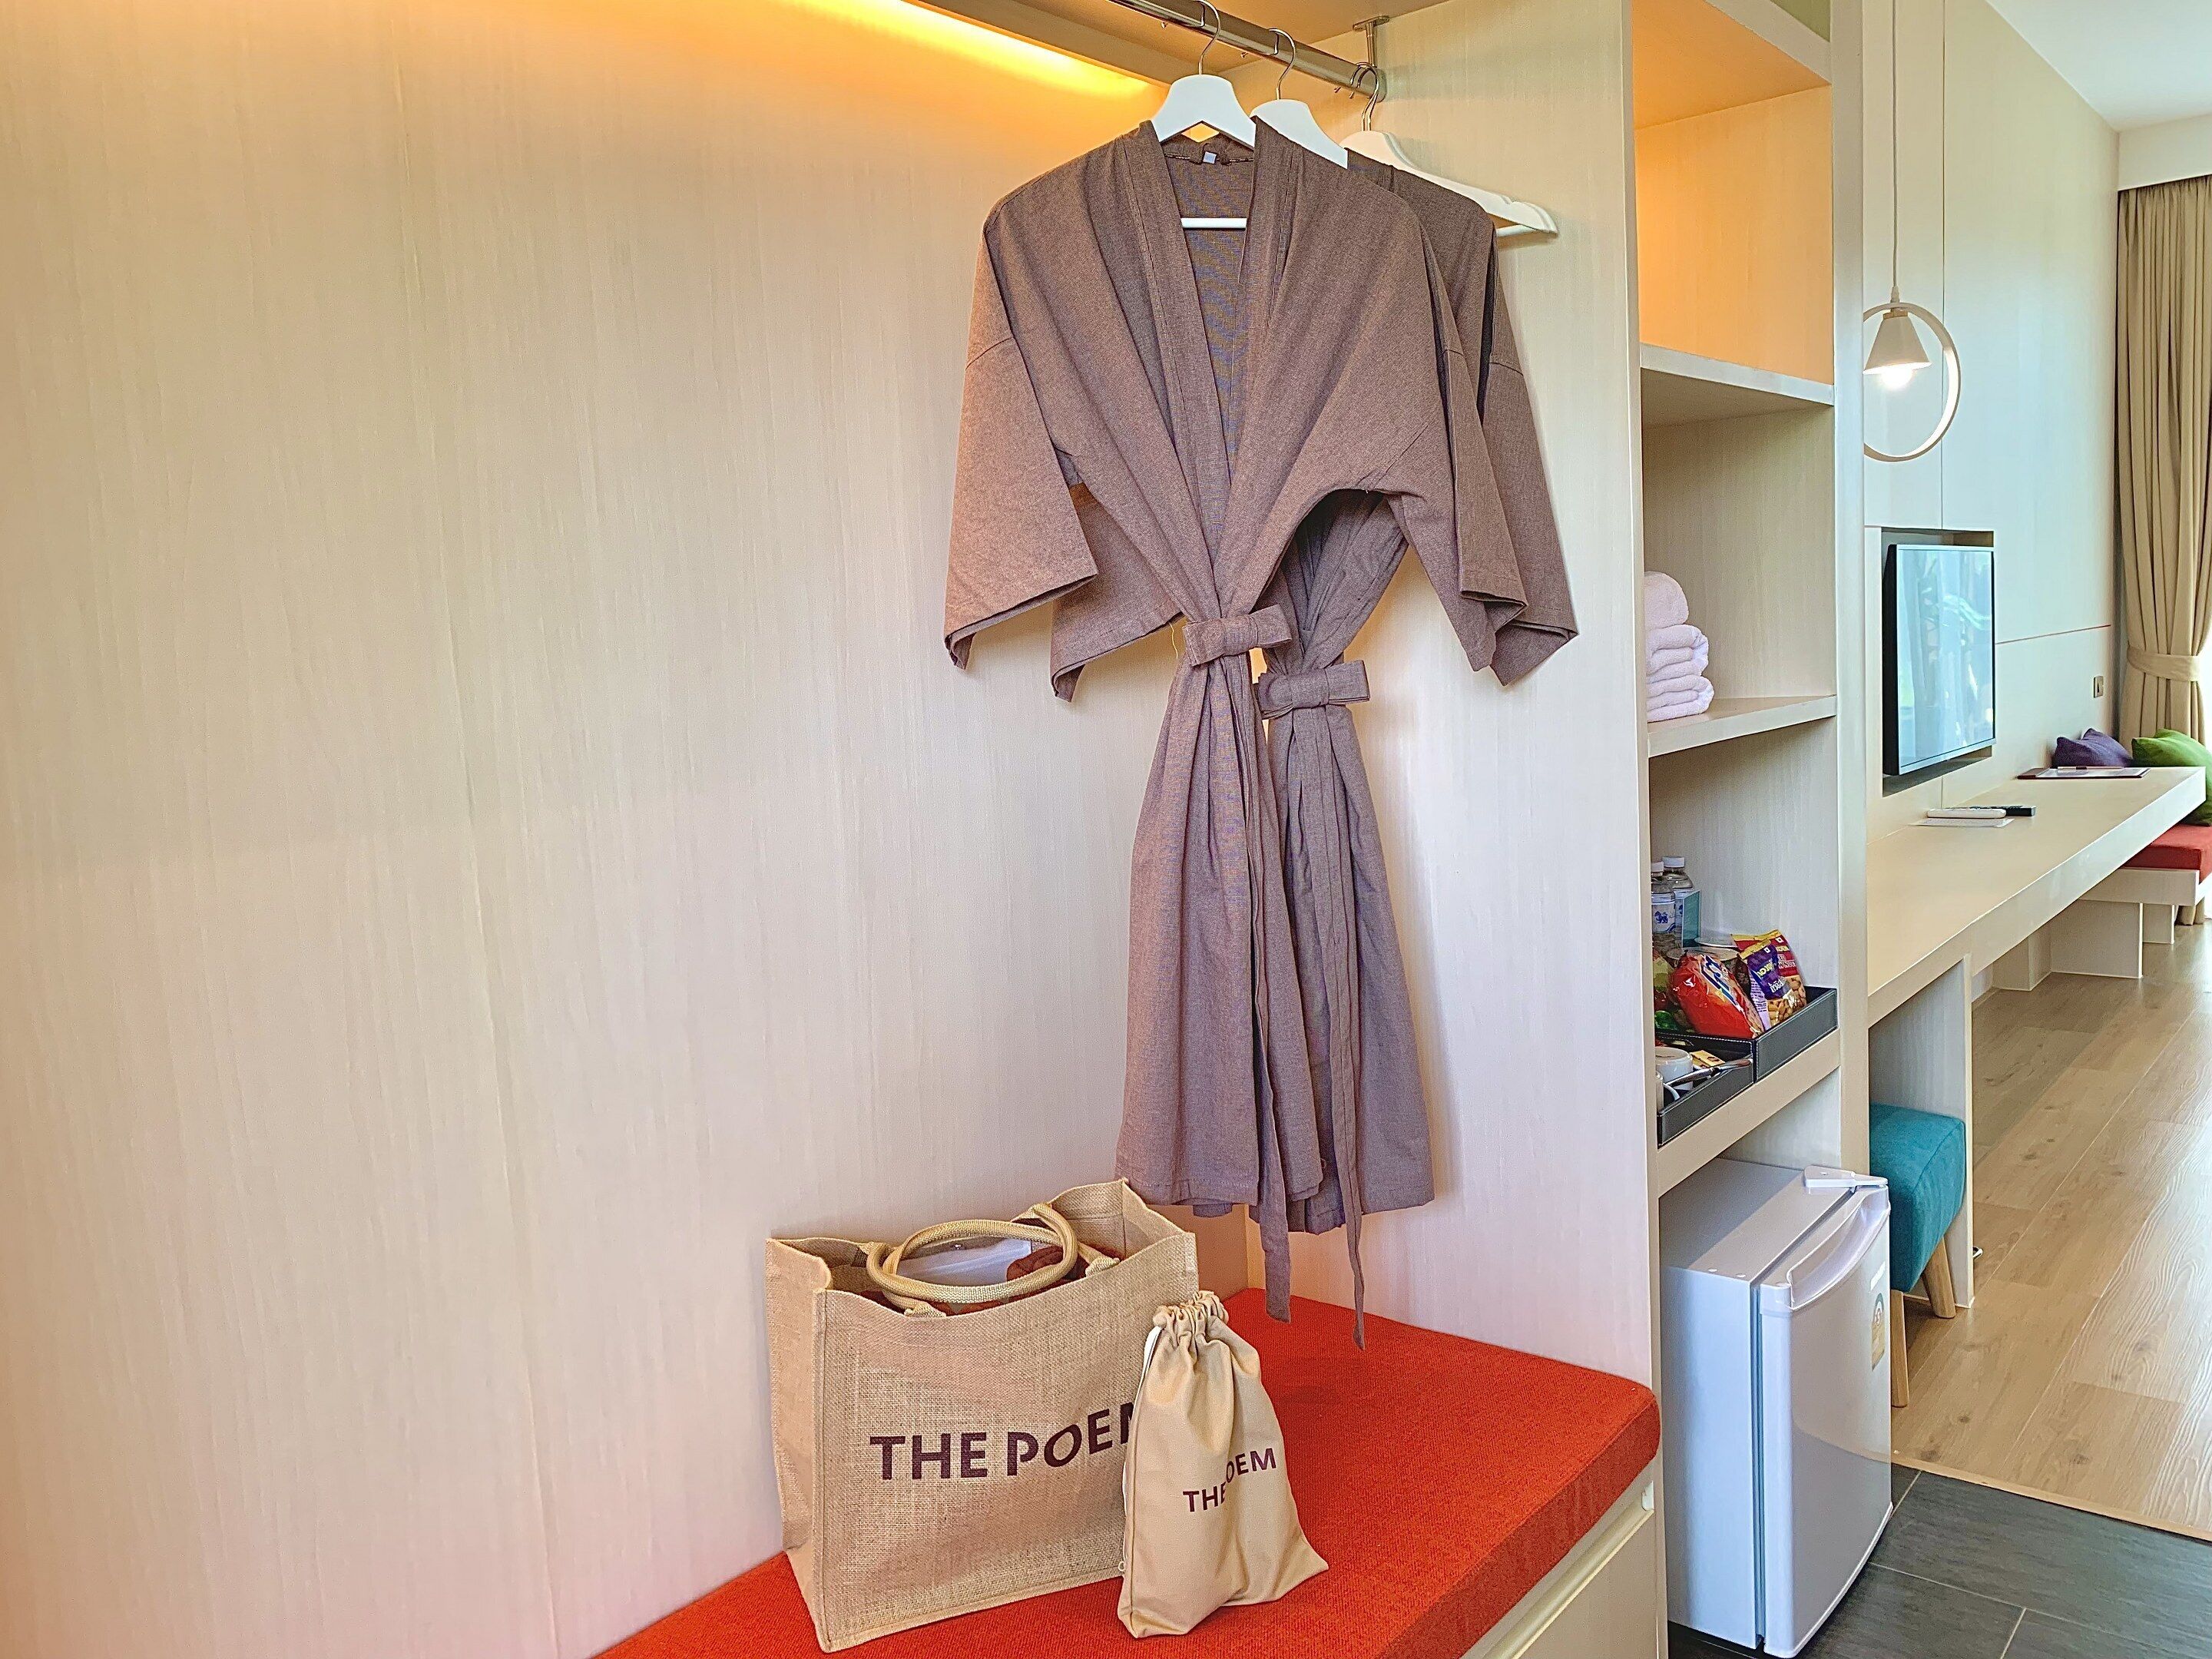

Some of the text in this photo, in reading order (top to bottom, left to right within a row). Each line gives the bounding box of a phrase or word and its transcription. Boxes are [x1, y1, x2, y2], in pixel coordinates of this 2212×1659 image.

[869, 1432, 988, 1480] THE
[1183, 1448, 1277, 1512] THE OEM
